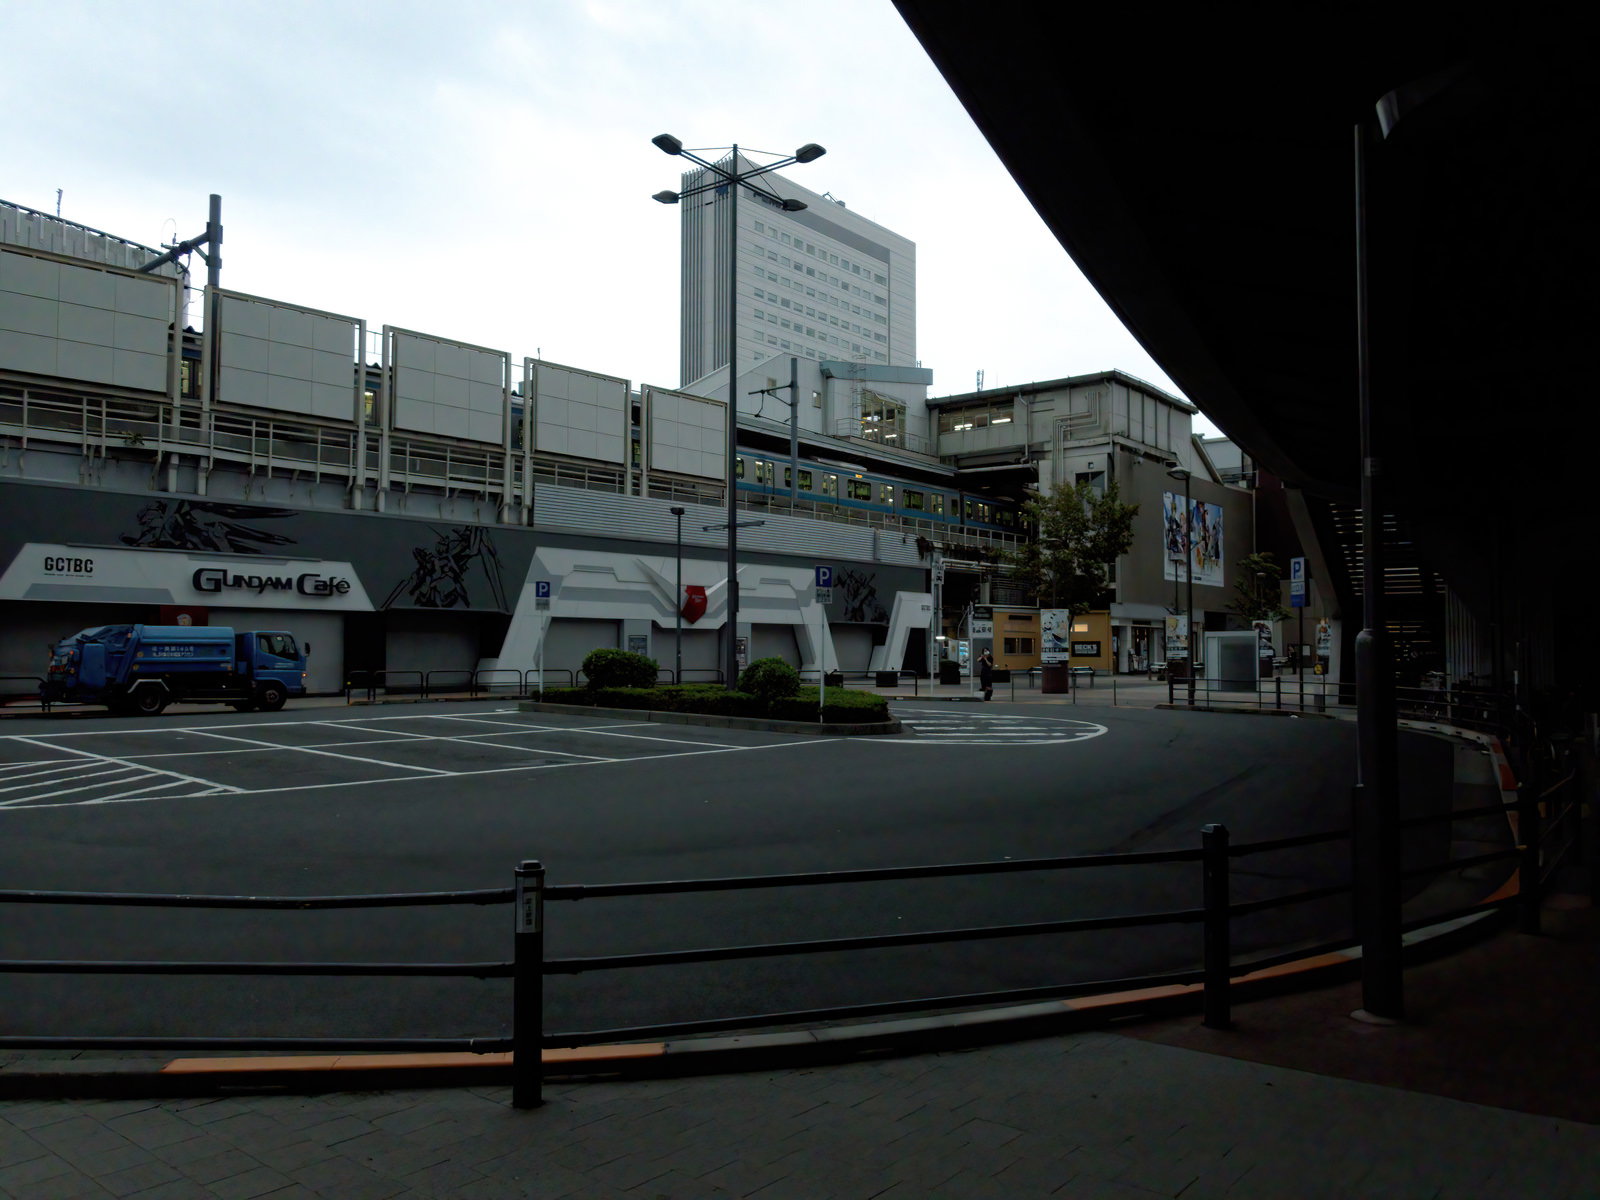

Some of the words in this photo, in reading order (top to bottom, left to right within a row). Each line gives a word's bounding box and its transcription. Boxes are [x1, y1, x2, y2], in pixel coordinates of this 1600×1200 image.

[44, 556, 94, 573] GCTBC
[1293, 561, 1302, 580] P
[192, 568, 293, 594] GUNDAM
[297, 573, 351, 596] Café
[819, 567, 830, 585] P
[538, 582, 549, 597] P
